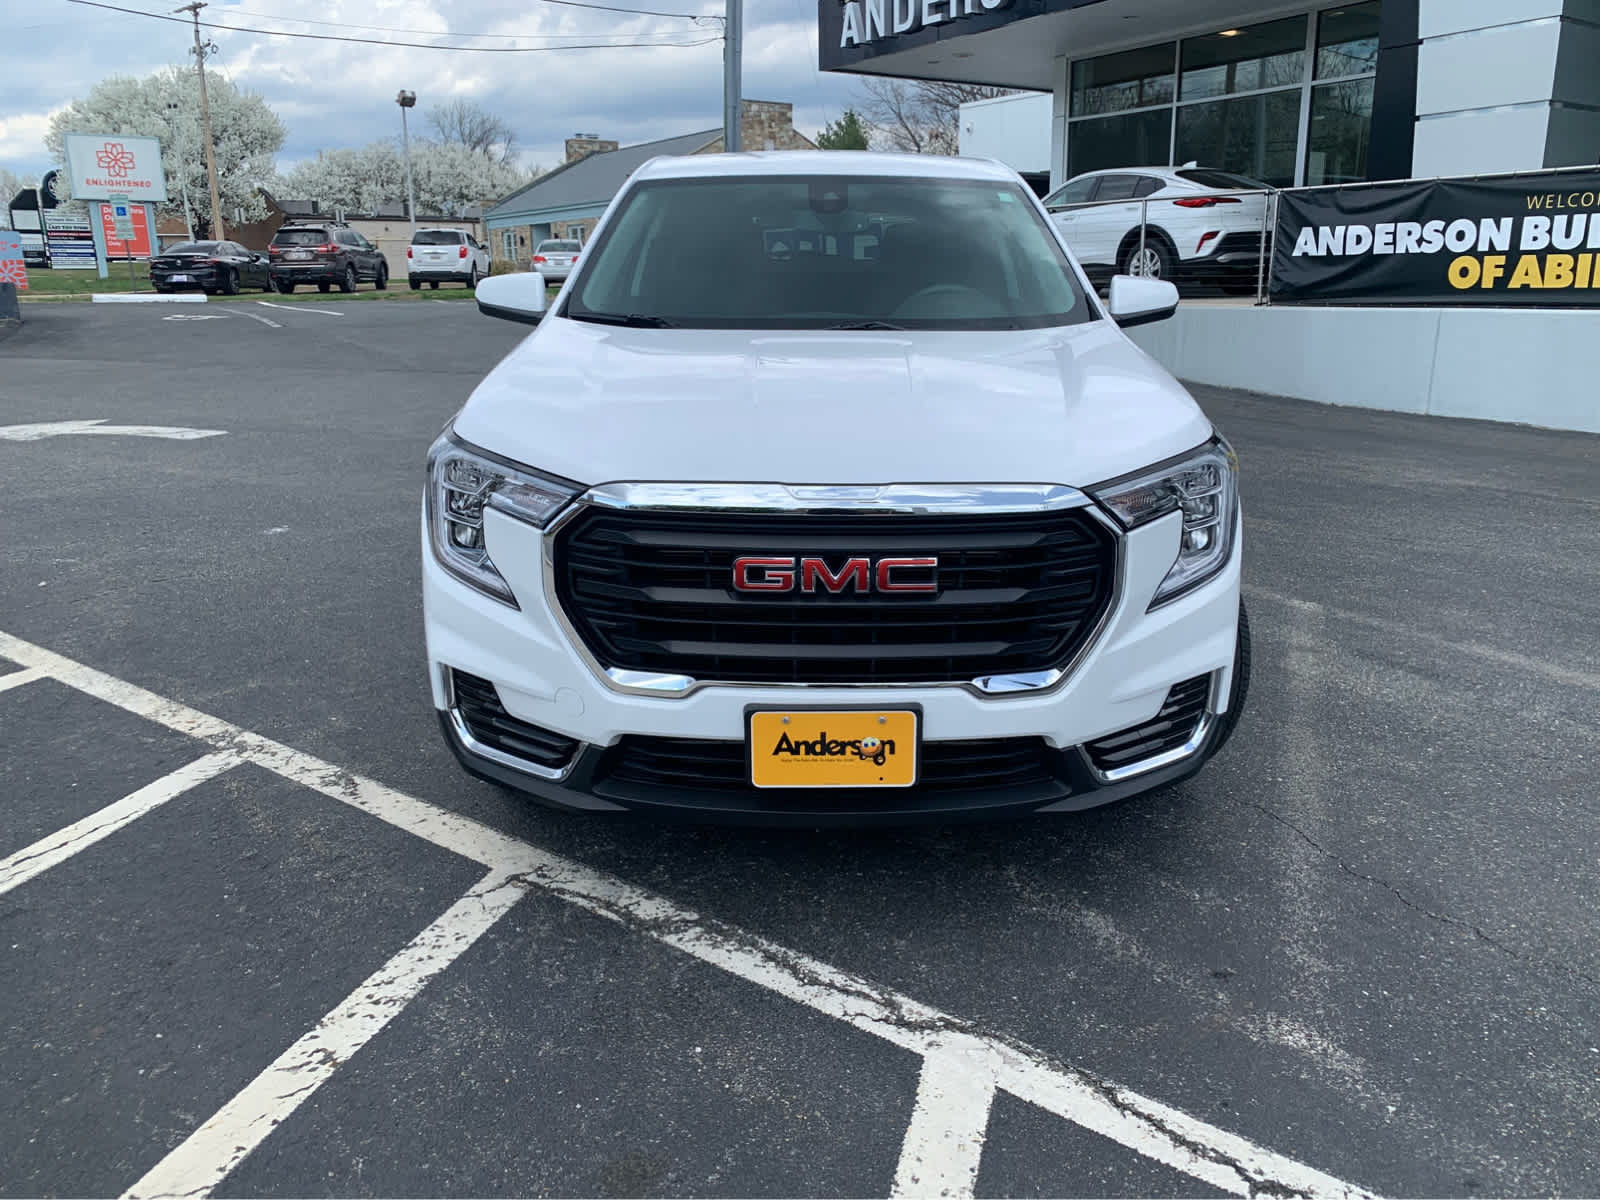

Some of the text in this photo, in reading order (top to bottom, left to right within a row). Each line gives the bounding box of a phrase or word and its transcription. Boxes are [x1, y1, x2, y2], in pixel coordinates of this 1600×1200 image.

[840, 0, 1000, 48] ANDE
[85, 177, 152, 188] ENLIGHTENED
[1527, 192, 1600, 209] WELCO
[1292, 217, 1513, 257] ANDERSON
[1448, 255, 1506, 289] OF
[733, 557, 938, 593] GMC
[772, 731, 895, 757] Anderson
